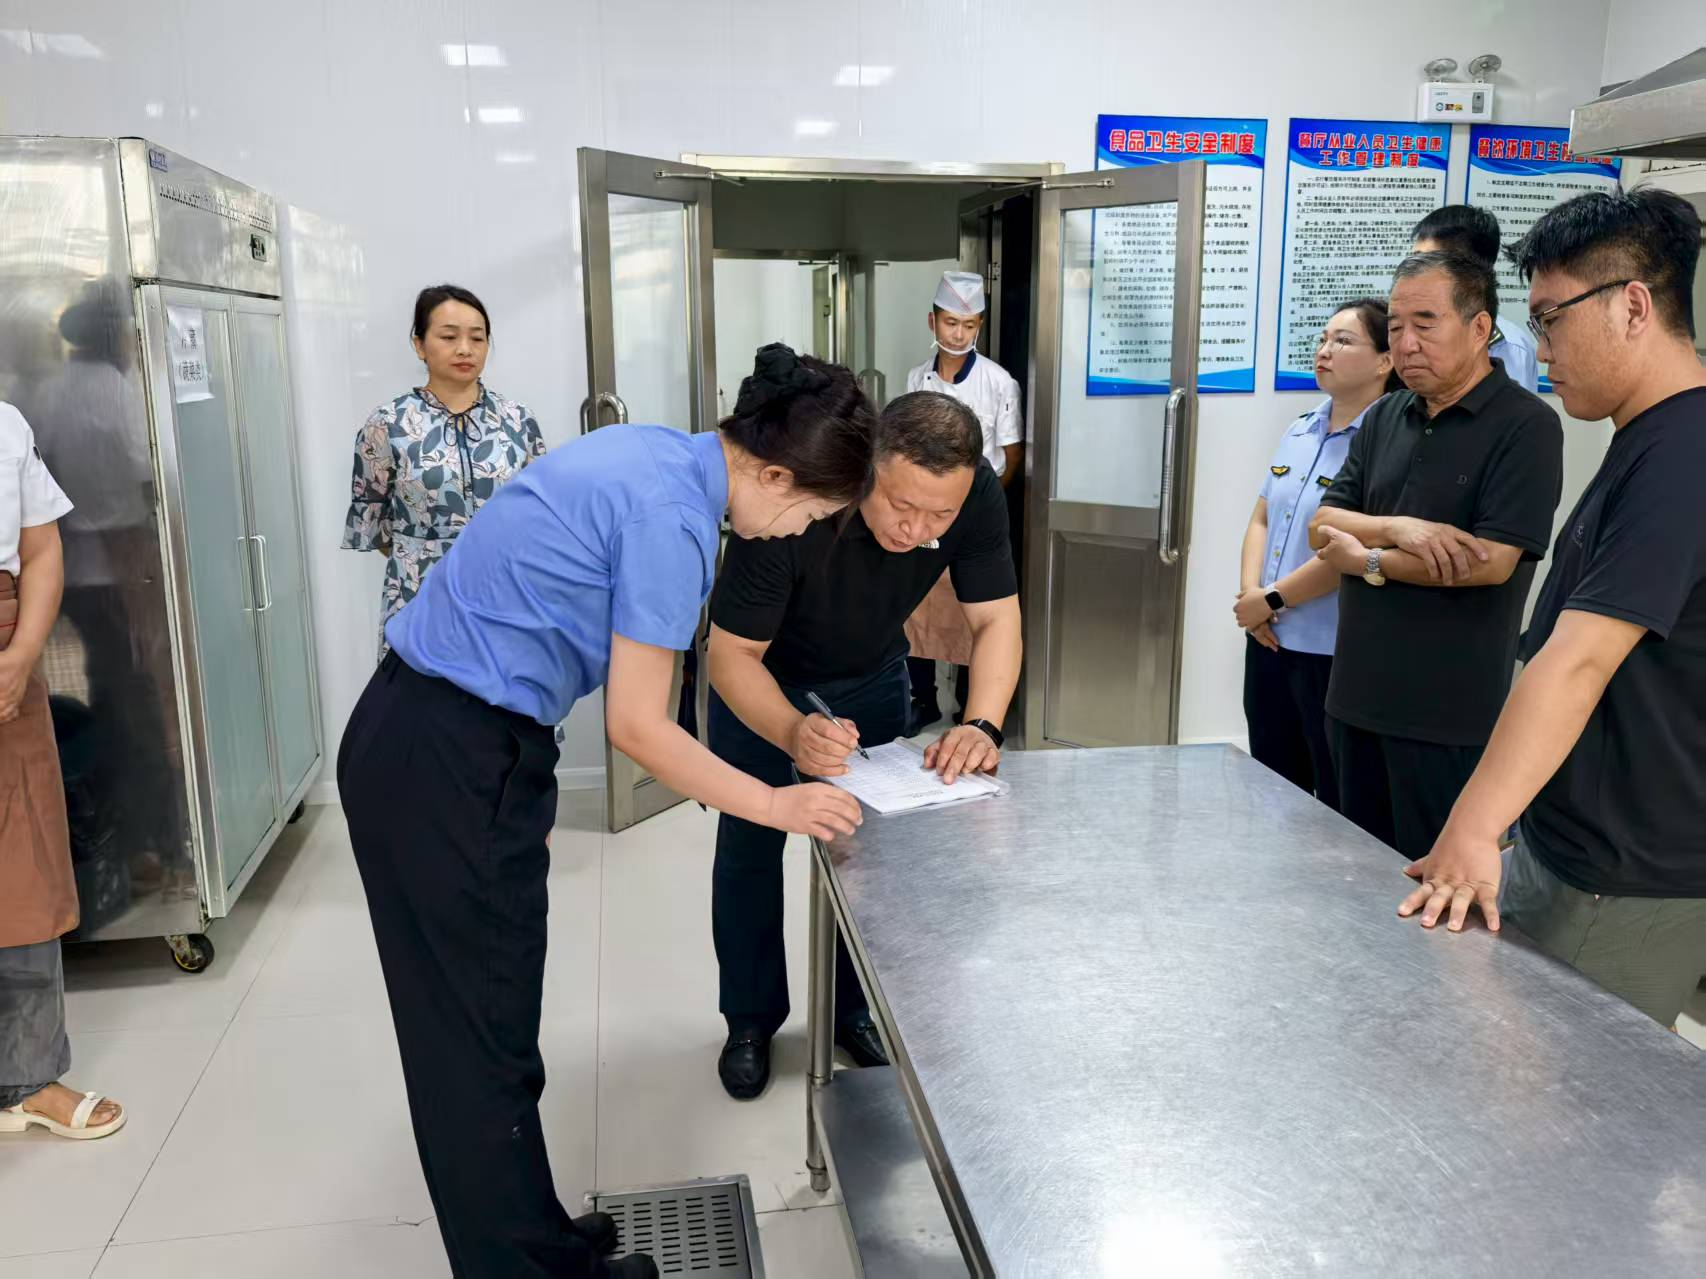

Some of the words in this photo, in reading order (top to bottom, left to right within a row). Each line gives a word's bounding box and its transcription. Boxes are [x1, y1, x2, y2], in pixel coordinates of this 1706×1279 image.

[1109, 129, 1256, 155] 食品卫生安全制度
[1298, 132, 1442, 151] 餐厅从业人员卫生健康
[1319, 150, 1419, 168] 工作管理制度
